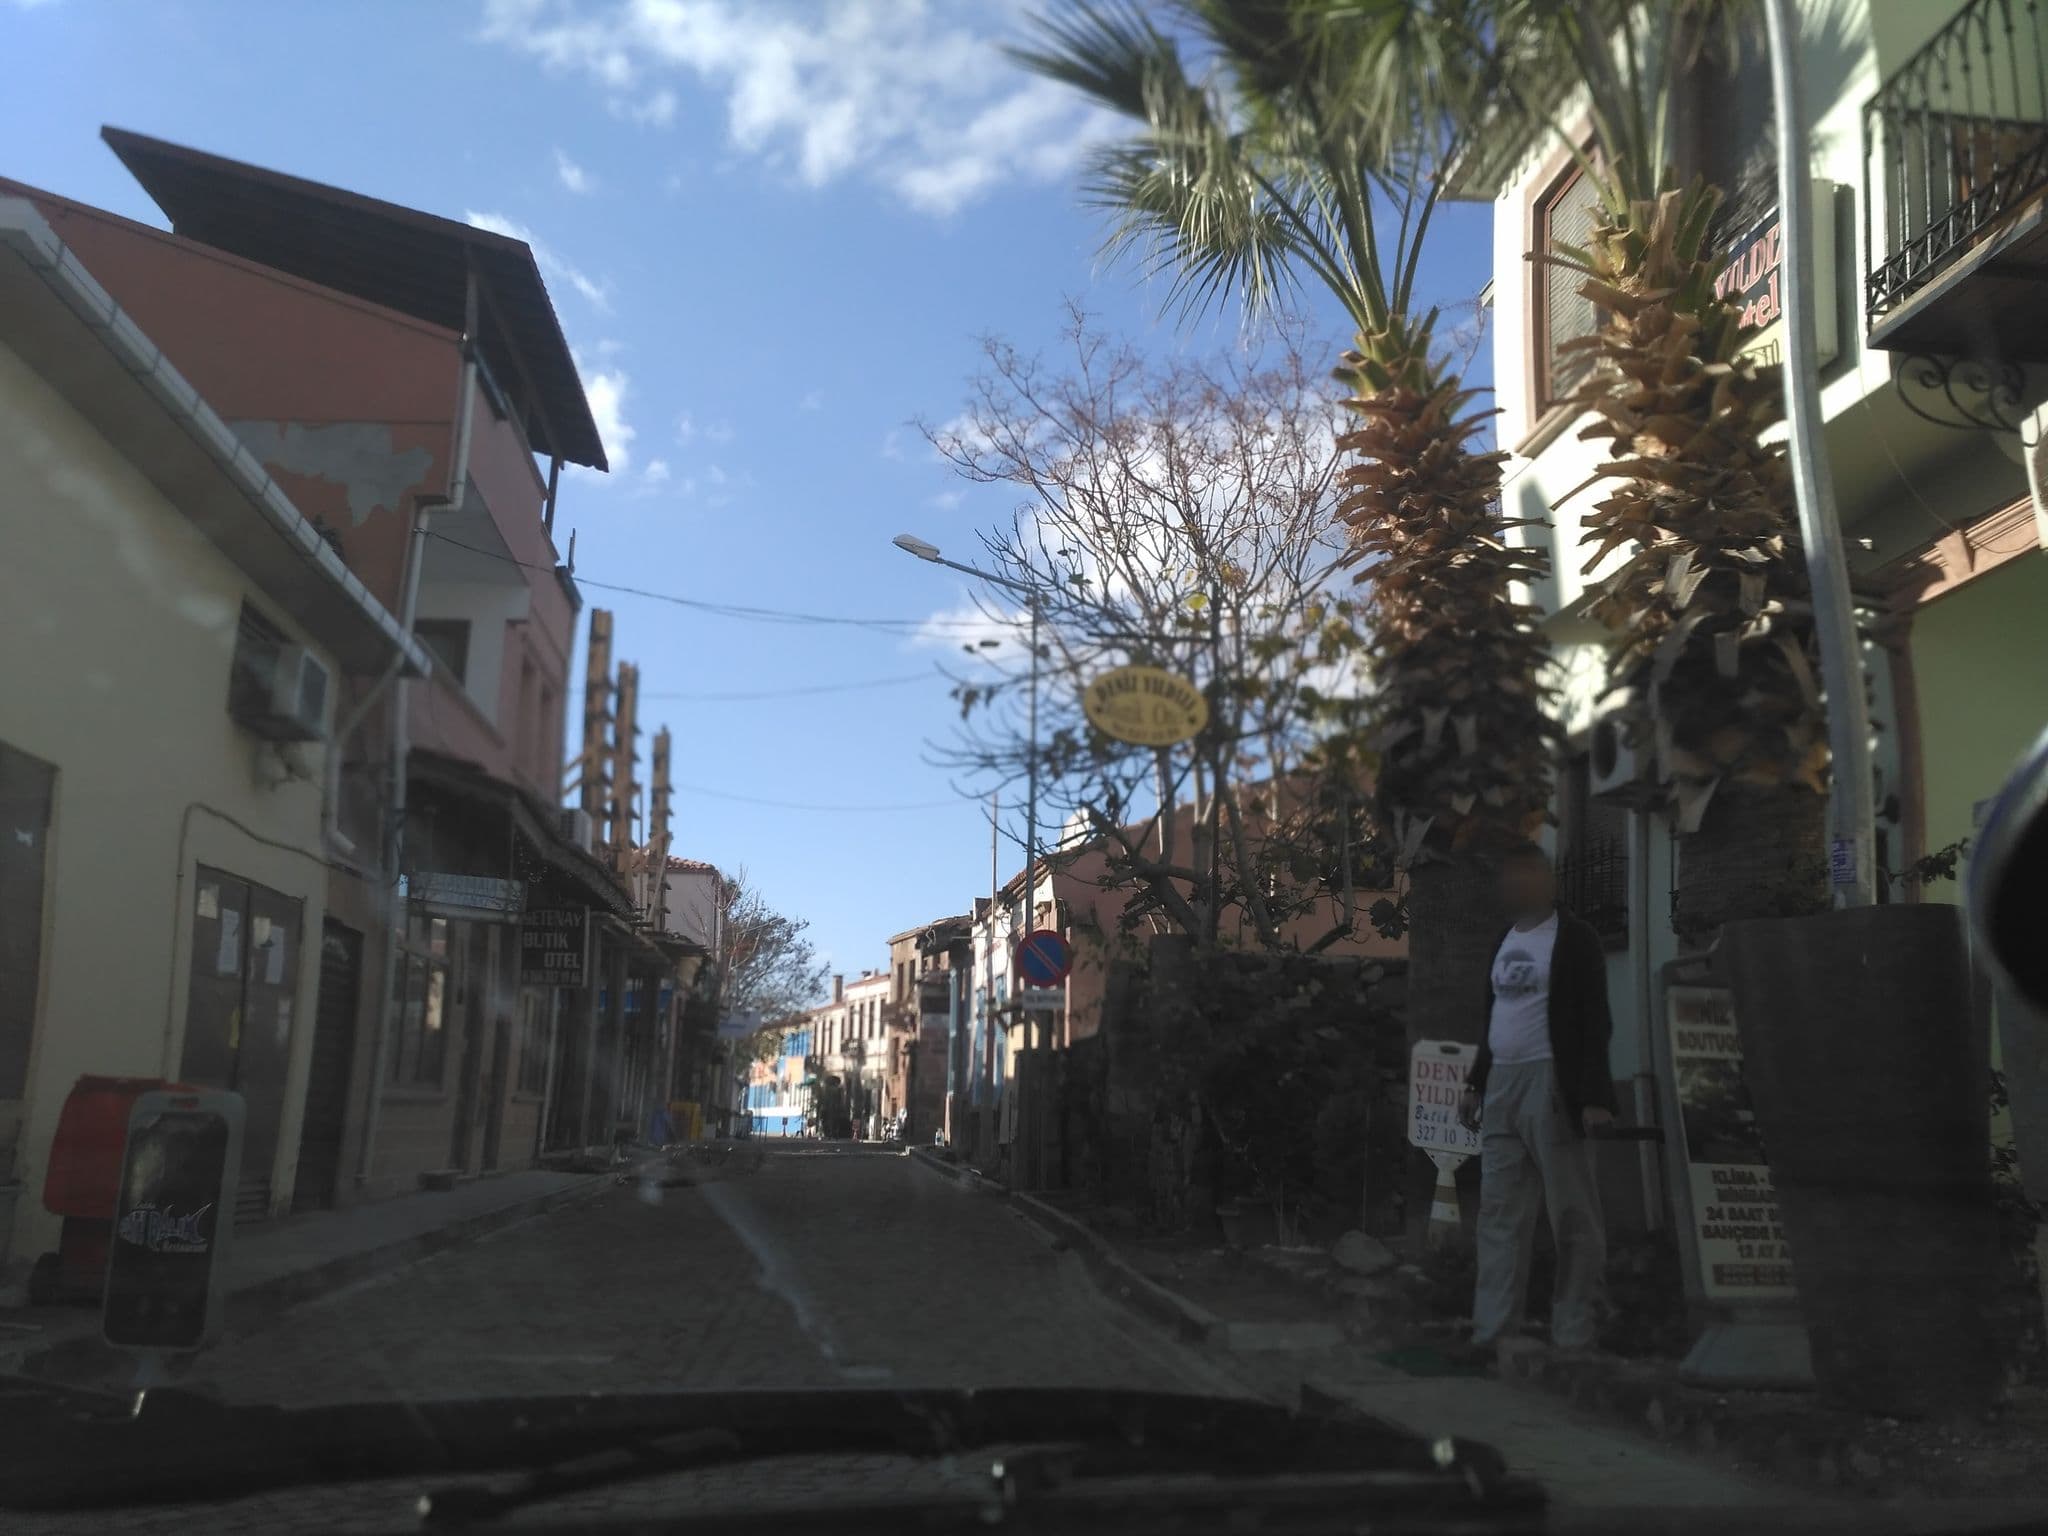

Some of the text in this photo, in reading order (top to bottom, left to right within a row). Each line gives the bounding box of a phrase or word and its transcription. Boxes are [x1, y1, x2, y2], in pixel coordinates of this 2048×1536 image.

[544, 951, 581, 969] OTEL
[1416, 1082, 1463, 1107] YILDI
[1416, 1123, 1436, 1141] 327
[1444, 1128, 1457, 1145] 10
[1706, 1206, 1724, 1221] 24
[1737, 1244, 1753, 1258] 12
